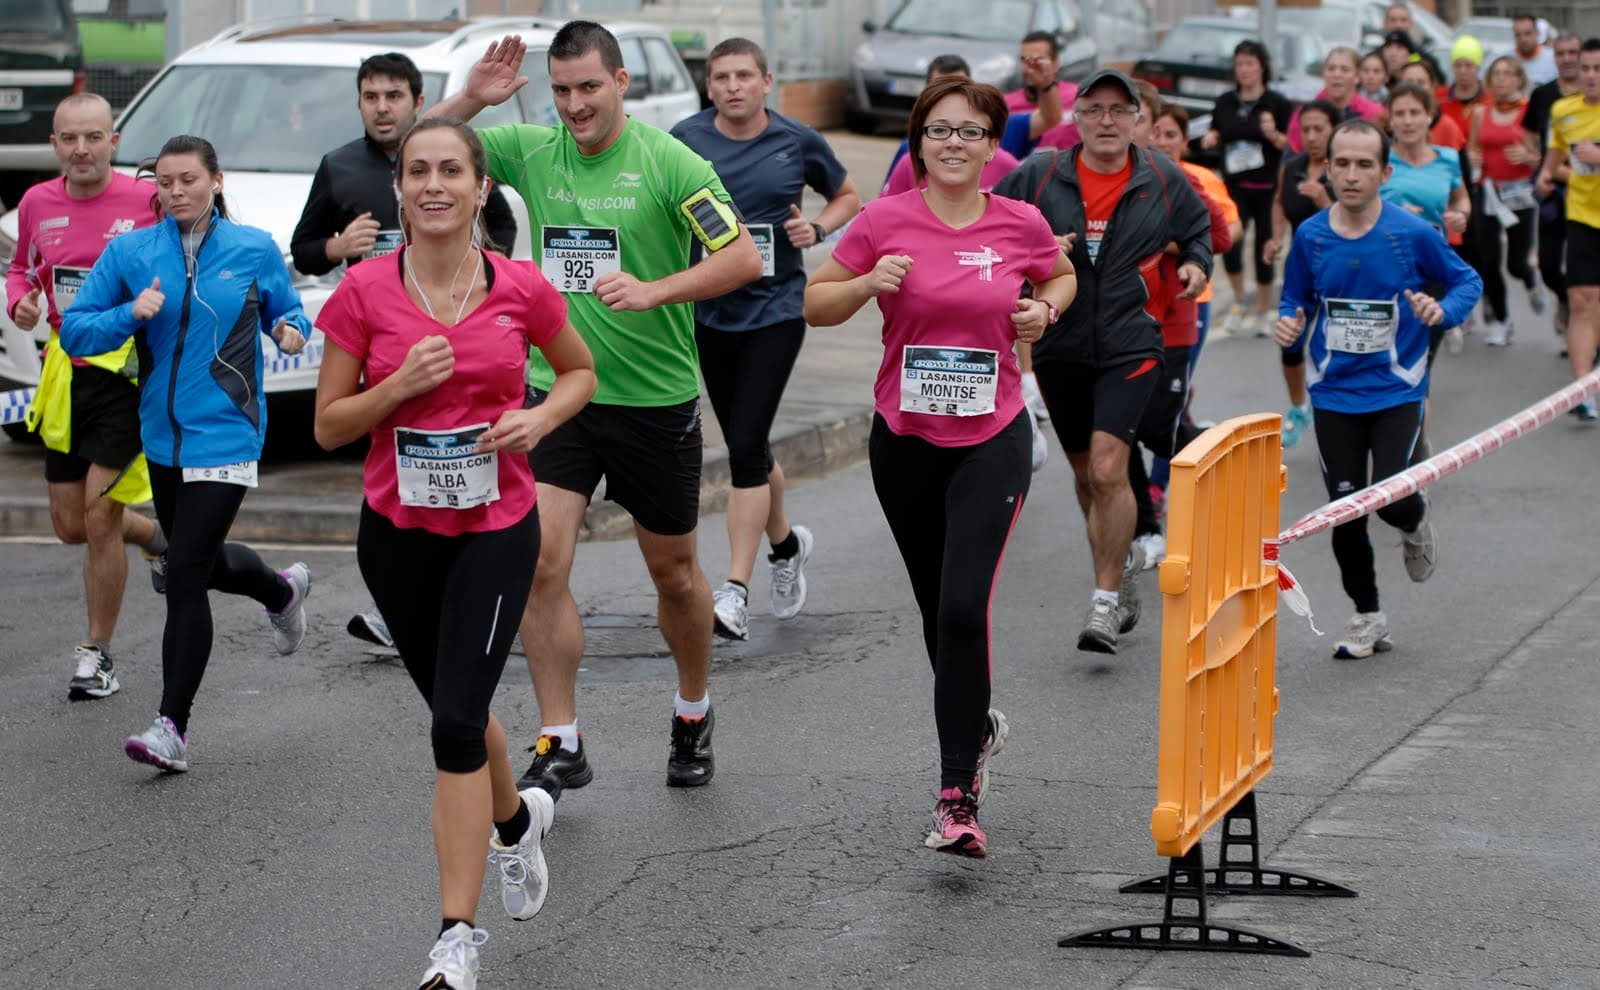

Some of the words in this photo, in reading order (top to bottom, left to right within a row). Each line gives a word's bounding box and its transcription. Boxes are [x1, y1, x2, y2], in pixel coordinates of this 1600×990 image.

[546, 186, 637, 211] LASNSI.COM
[551, 239, 612, 249] POWERADE
[556, 251, 616, 260] LASANSI.COM
[564, 260, 595, 279] 925
[1344, 327, 1375, 339] ENRIC
[914, 360, 989, 372] POWERADE
[920, 372, 992, 385] LASANSI.COM
[921, 383, 977, 400] MONTSE
[406, 445, 475, 457] POWERAD
[414, 455, 492, 471] LASANSI.COM
[428, 473, 466, 488] ALBA
